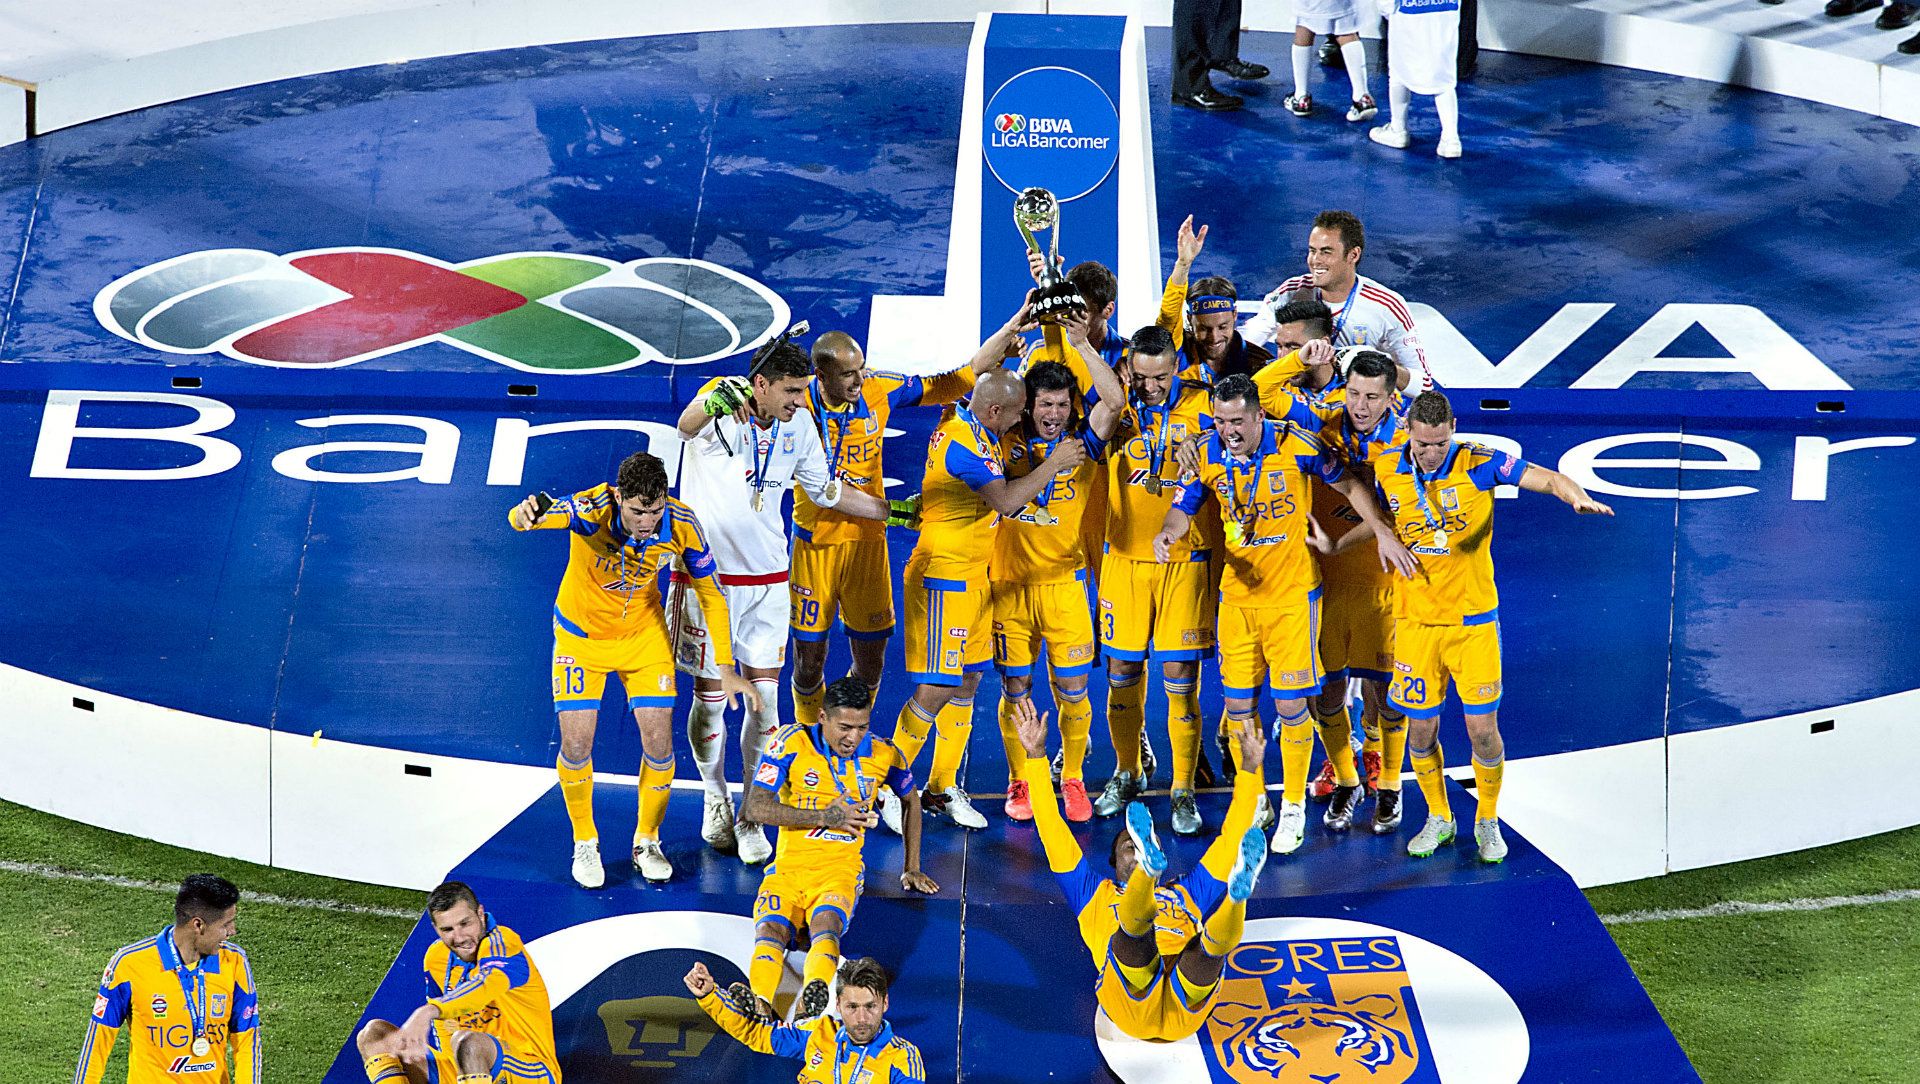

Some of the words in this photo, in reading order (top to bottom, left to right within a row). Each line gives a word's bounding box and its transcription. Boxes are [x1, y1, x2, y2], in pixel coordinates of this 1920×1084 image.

[1029, 118, 1073, 133] BBVA
[991, 133, 1028, 147] LIGA
[1029, 133, 1109, 149] Bancomer
[751, 480, 783, 488] CMEX
[1019, 514, 1058, 525] CEX
[1224, 494, 1297, 525] GRES
[1253, 534, 1287, 547] CEMEX
[1414, 546, 1450, 555] CEMEX
[800, 598, 820, 627] 19
[1104, 613, 1115, 641] 3
[699, 642, 706, 671] 1
[993, 632, 1008, 661] 11
[564, 666, 584, 695] 13
[1403, 676, 1426, 704] 29
[757, 894, 781, 916] 20
[1227, 939, 1401, 976] GRES
[147, 1024, 226, 1048] TIGES
[184, 1062, 216, 1072] CEMEX
